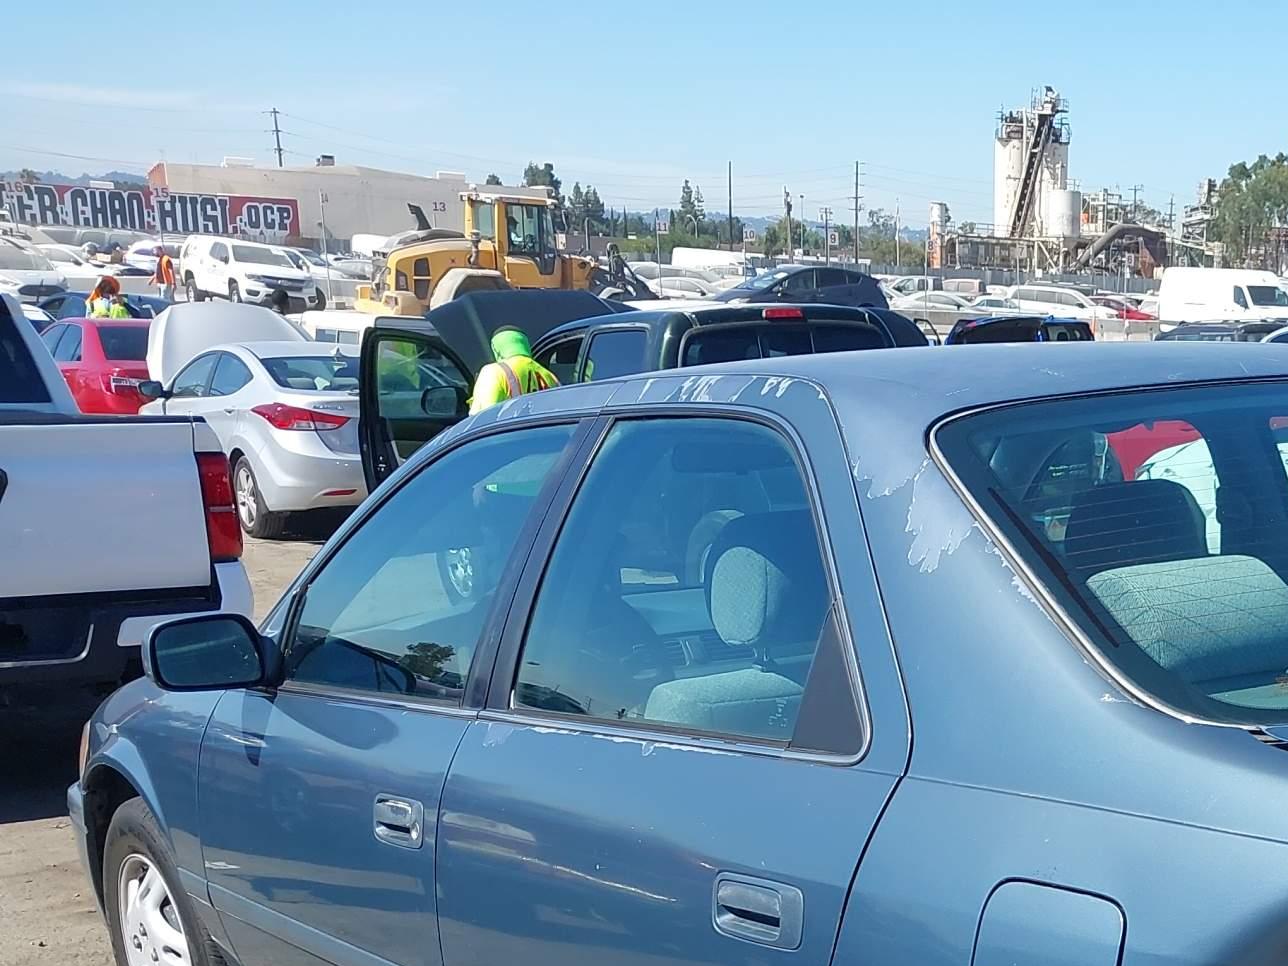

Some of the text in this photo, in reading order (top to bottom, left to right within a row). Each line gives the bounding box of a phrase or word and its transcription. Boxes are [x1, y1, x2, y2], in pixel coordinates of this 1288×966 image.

[7, 182, 23, 192] 16
[154, 187, 169, 198] 15
[320, 193, 328, 204] 14
[432, 202, 446, 212] 13
[246, 203, 292, 231] OCP
[656, 222, 667, 232] 11
[744, 230, 755, 240] 10
[829, 233, 836, 244] 9
[927, 241, 934, 251] 8
